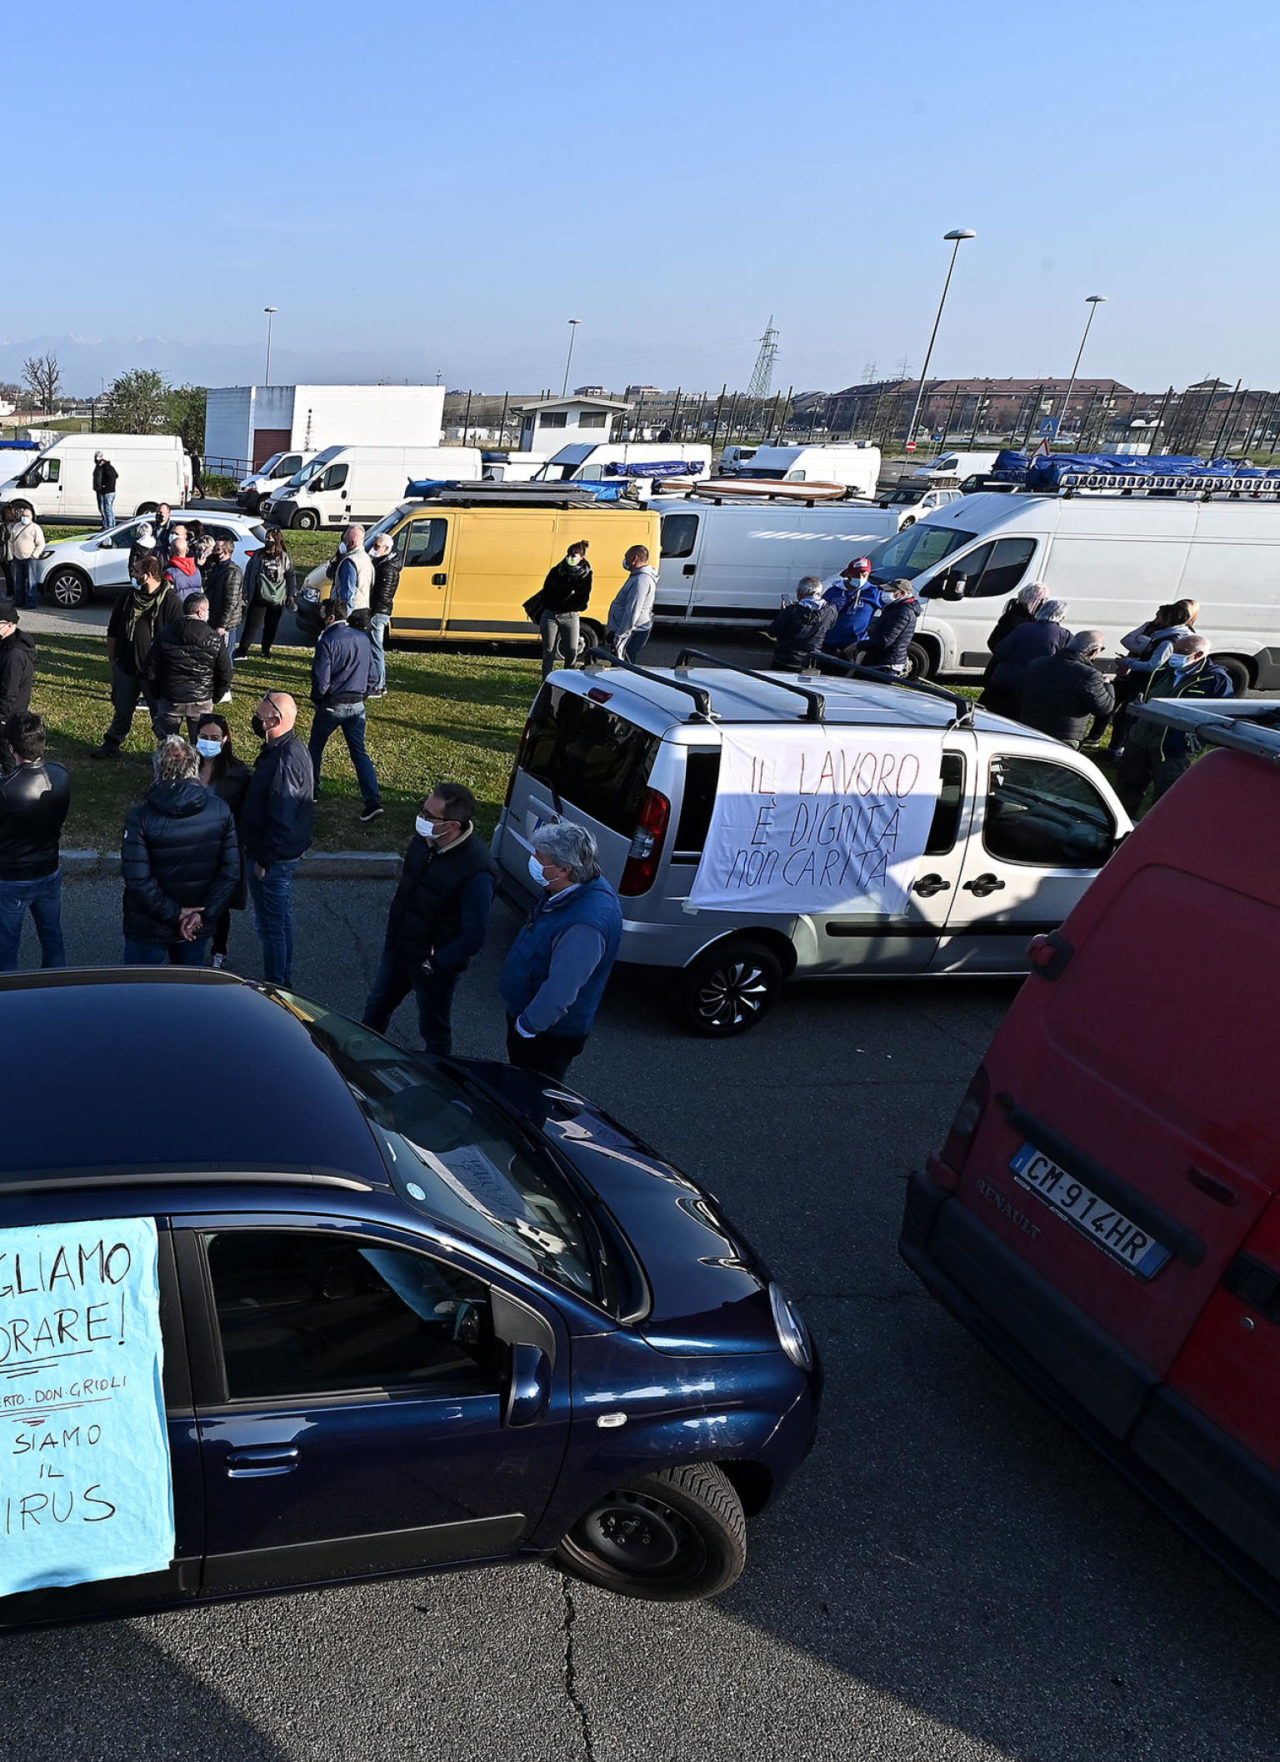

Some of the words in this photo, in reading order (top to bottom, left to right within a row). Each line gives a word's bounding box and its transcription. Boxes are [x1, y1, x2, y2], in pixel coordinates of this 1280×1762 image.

[752, 756, 776, 794] IL
[799, 749, 920, 798] LAVORO
[976, 1180, 1042, 1239] RENAULT
[12, 1424, 102, 1455] SIAMO
